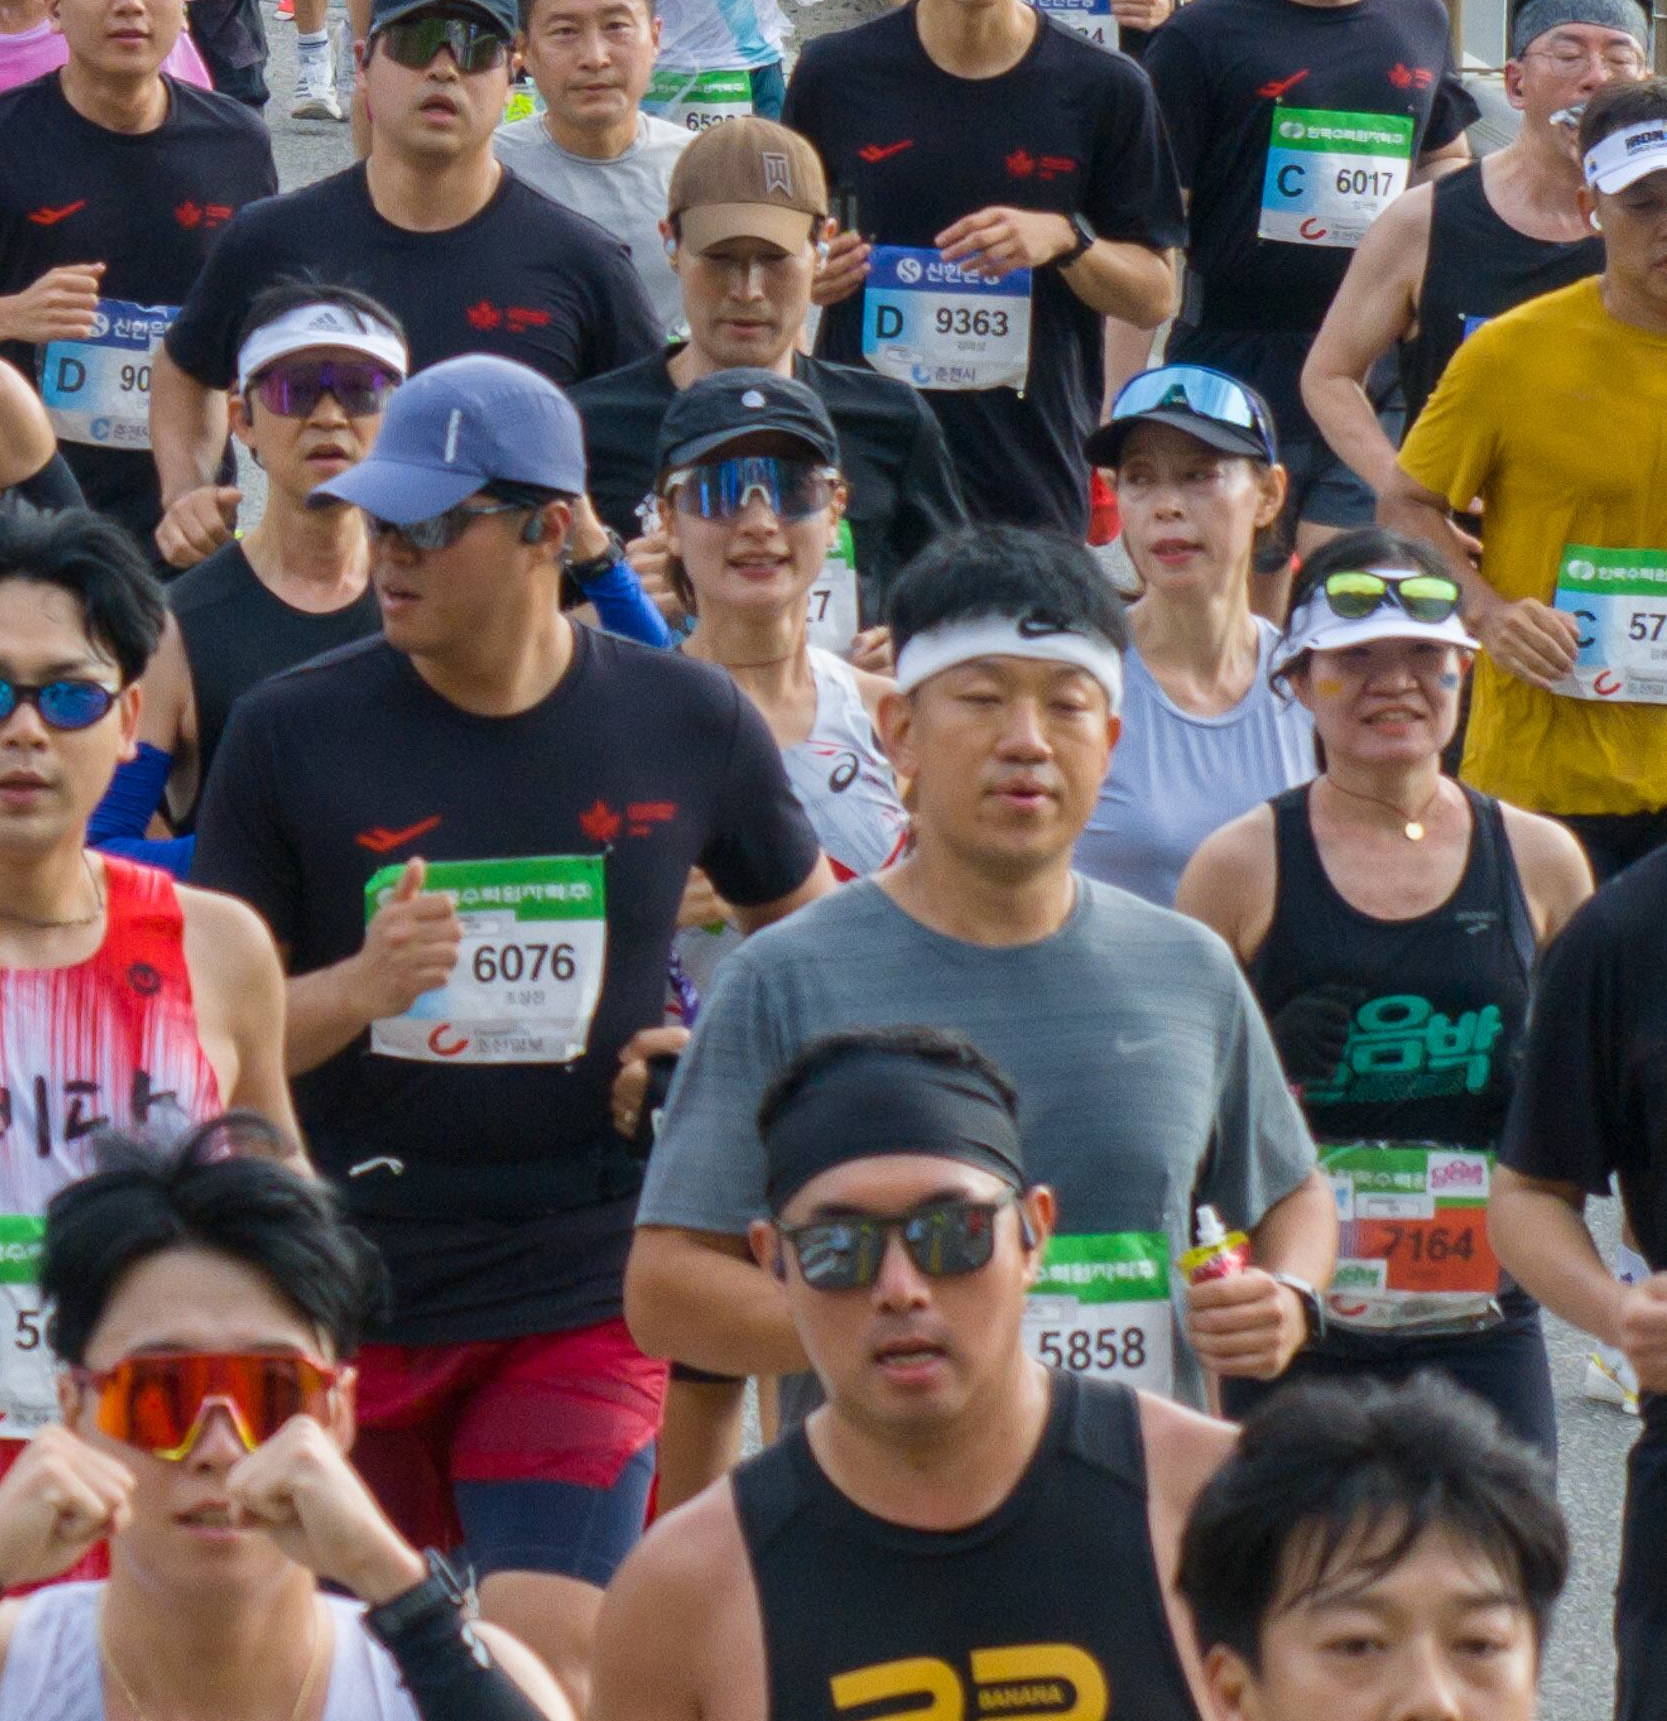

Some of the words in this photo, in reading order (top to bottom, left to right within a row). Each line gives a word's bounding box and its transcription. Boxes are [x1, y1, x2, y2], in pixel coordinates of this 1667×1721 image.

[1278, 165, 1303, 198] C
[1336, 168, 1394, 198] 6017
[876, 306, 904, 341] D
[934, 307, 1009, 338] 9363
[58, 359, 85, 393] D
[473, 943, 576, 983] 6076
[1379, 1227, 1475, 1264] 7164
[1038, 1328, 1146, 1370] 5858
[978, 1684, 1065, 1709] BANANA
